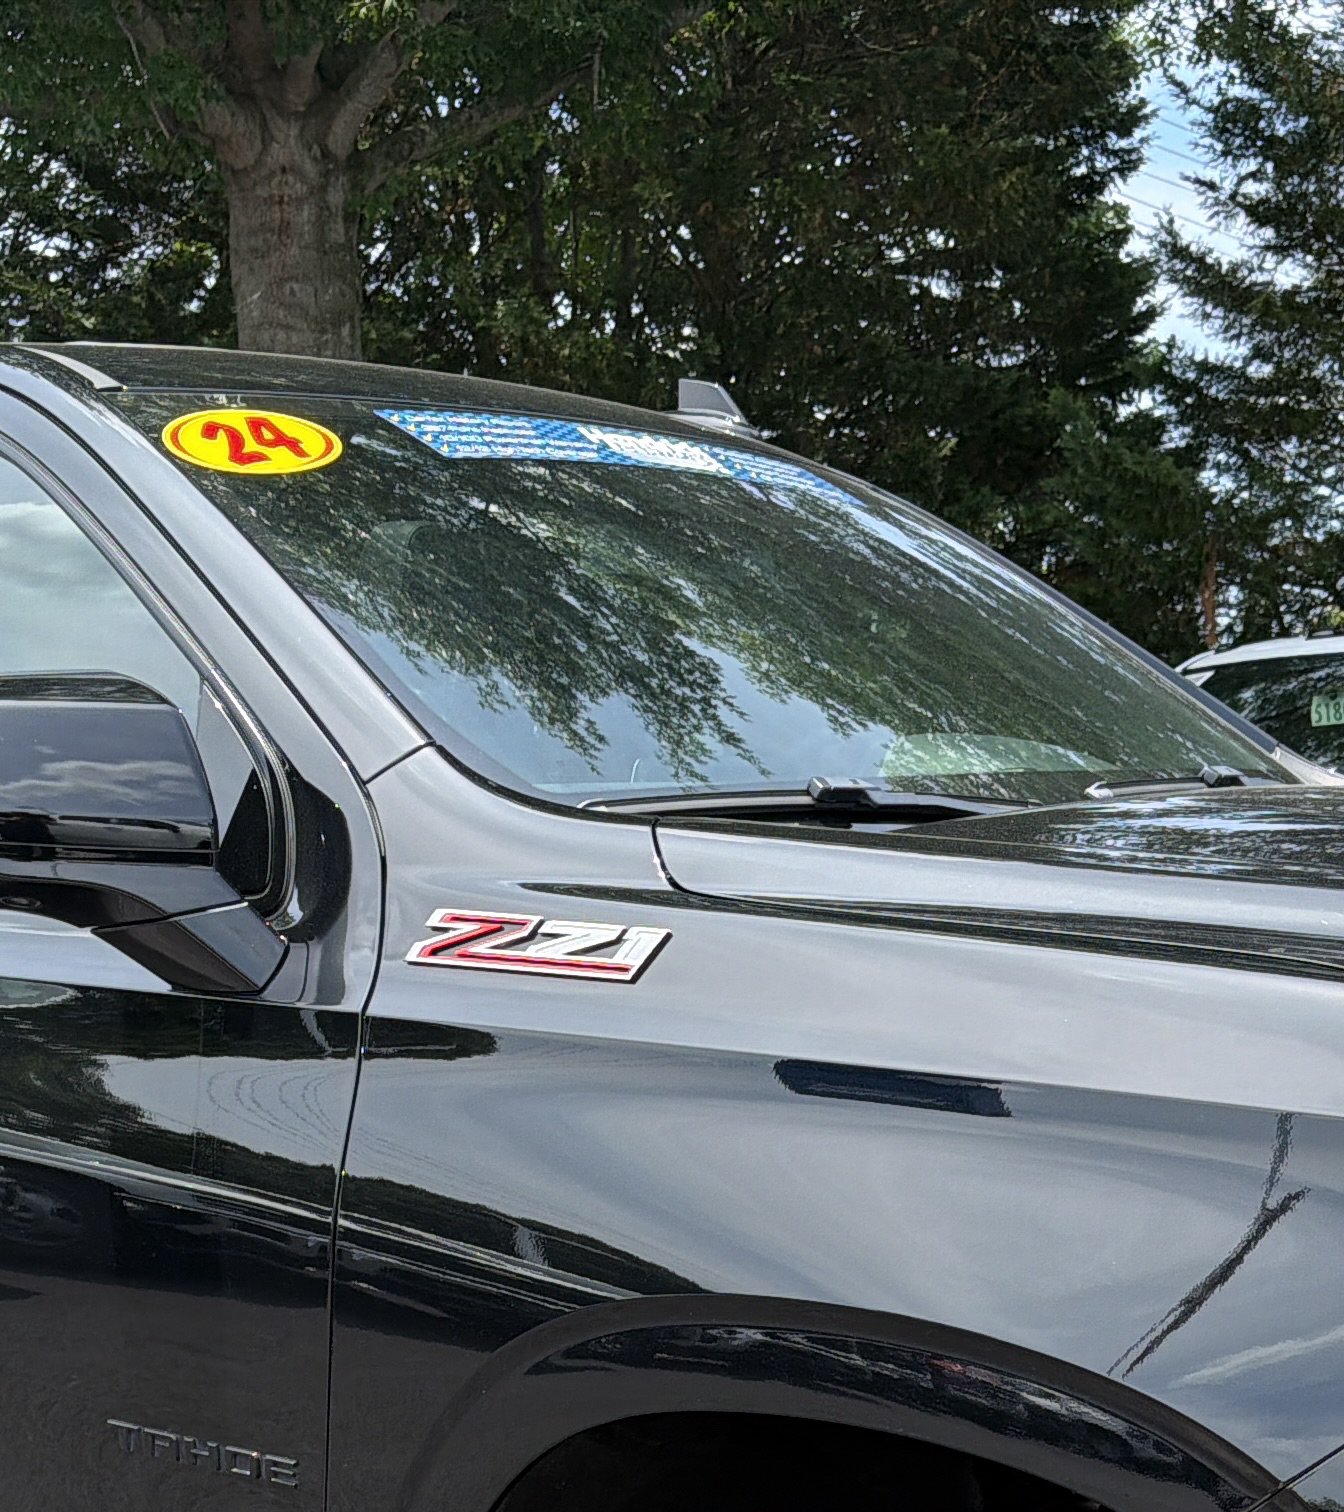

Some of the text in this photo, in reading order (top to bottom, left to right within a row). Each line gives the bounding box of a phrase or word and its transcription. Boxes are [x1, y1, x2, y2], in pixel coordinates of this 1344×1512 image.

[201, 415, 306, 464] 24
[405, 907, 672, 984] Z71
[106, 1418, 298, 1489] TAHOE
